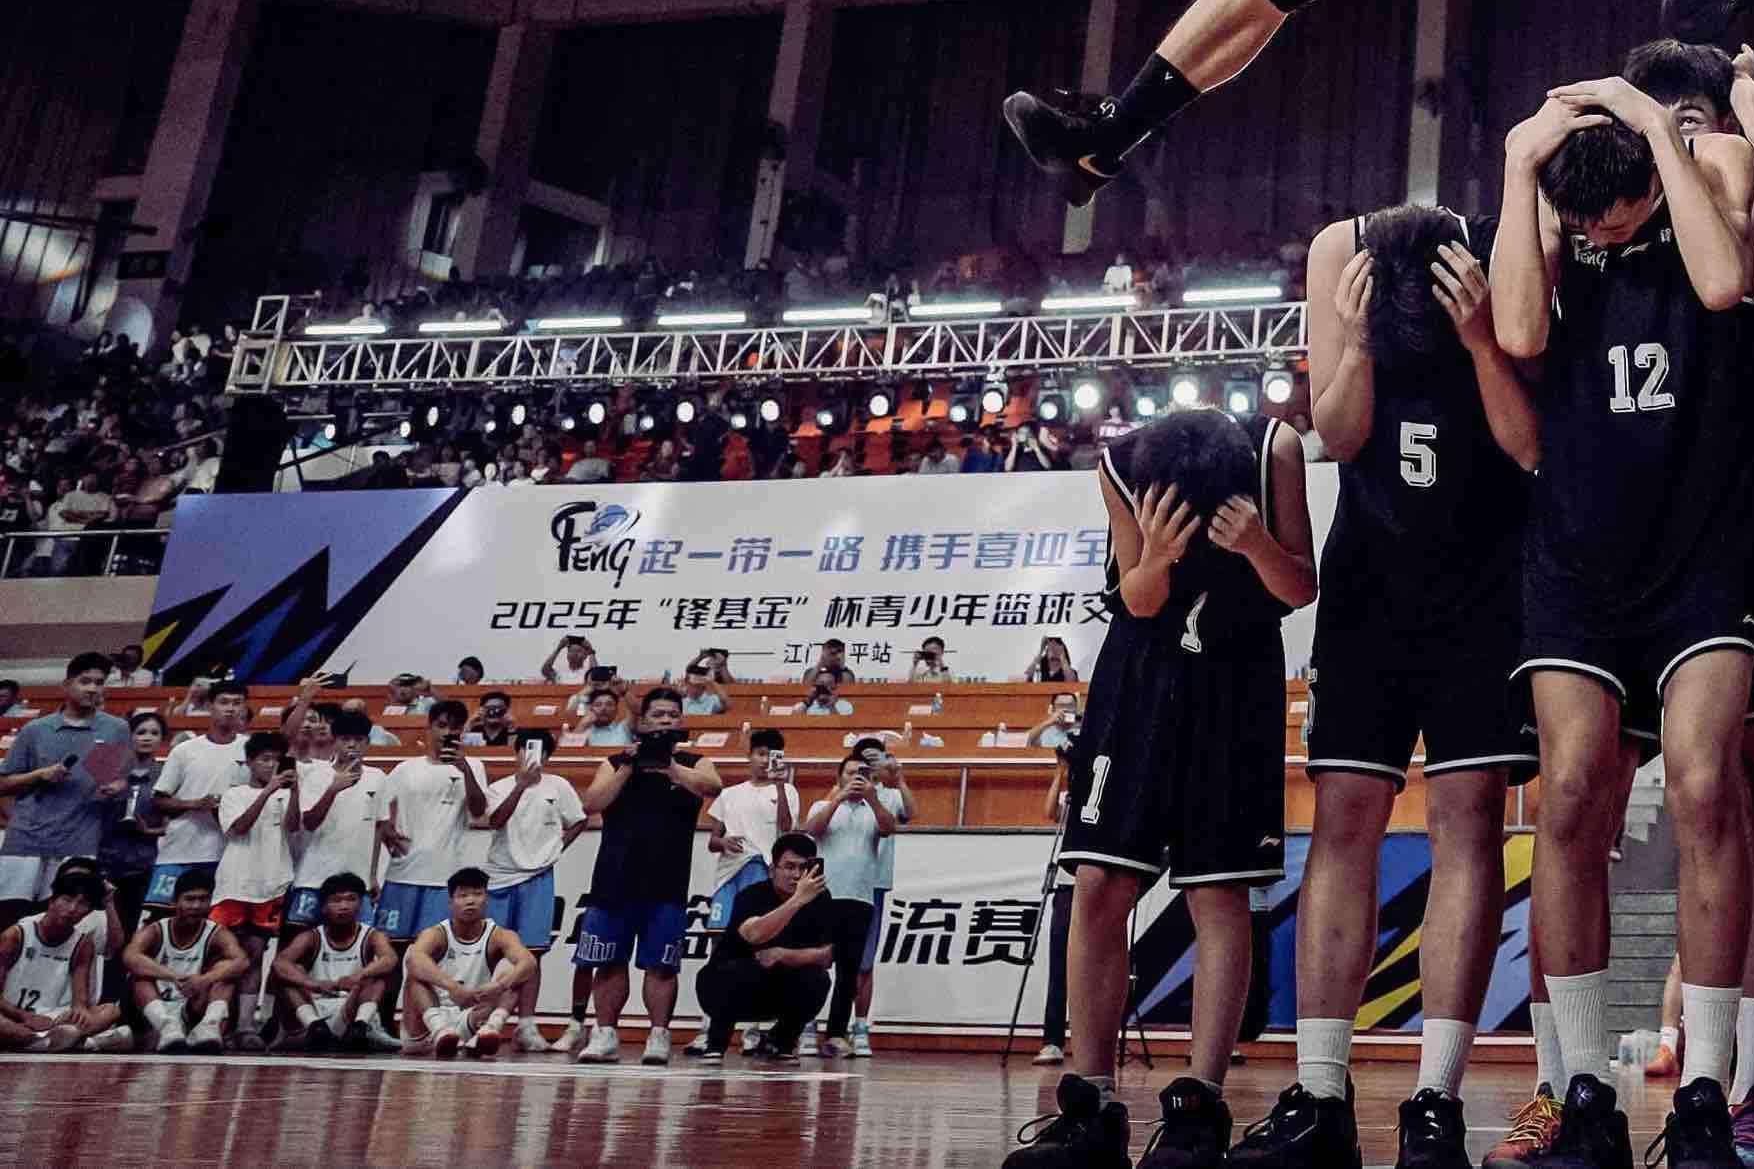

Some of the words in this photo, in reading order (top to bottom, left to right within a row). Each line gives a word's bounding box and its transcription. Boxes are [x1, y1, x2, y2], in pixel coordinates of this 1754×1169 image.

[1606, 342, 1676, 413] 12
[1399, 421, 1438, 488] 5
[638, 534, 866, 575] 起一带一路
[783, 642, 892, 664] 江门平站
[1080, 754, 1112, 825] 1
